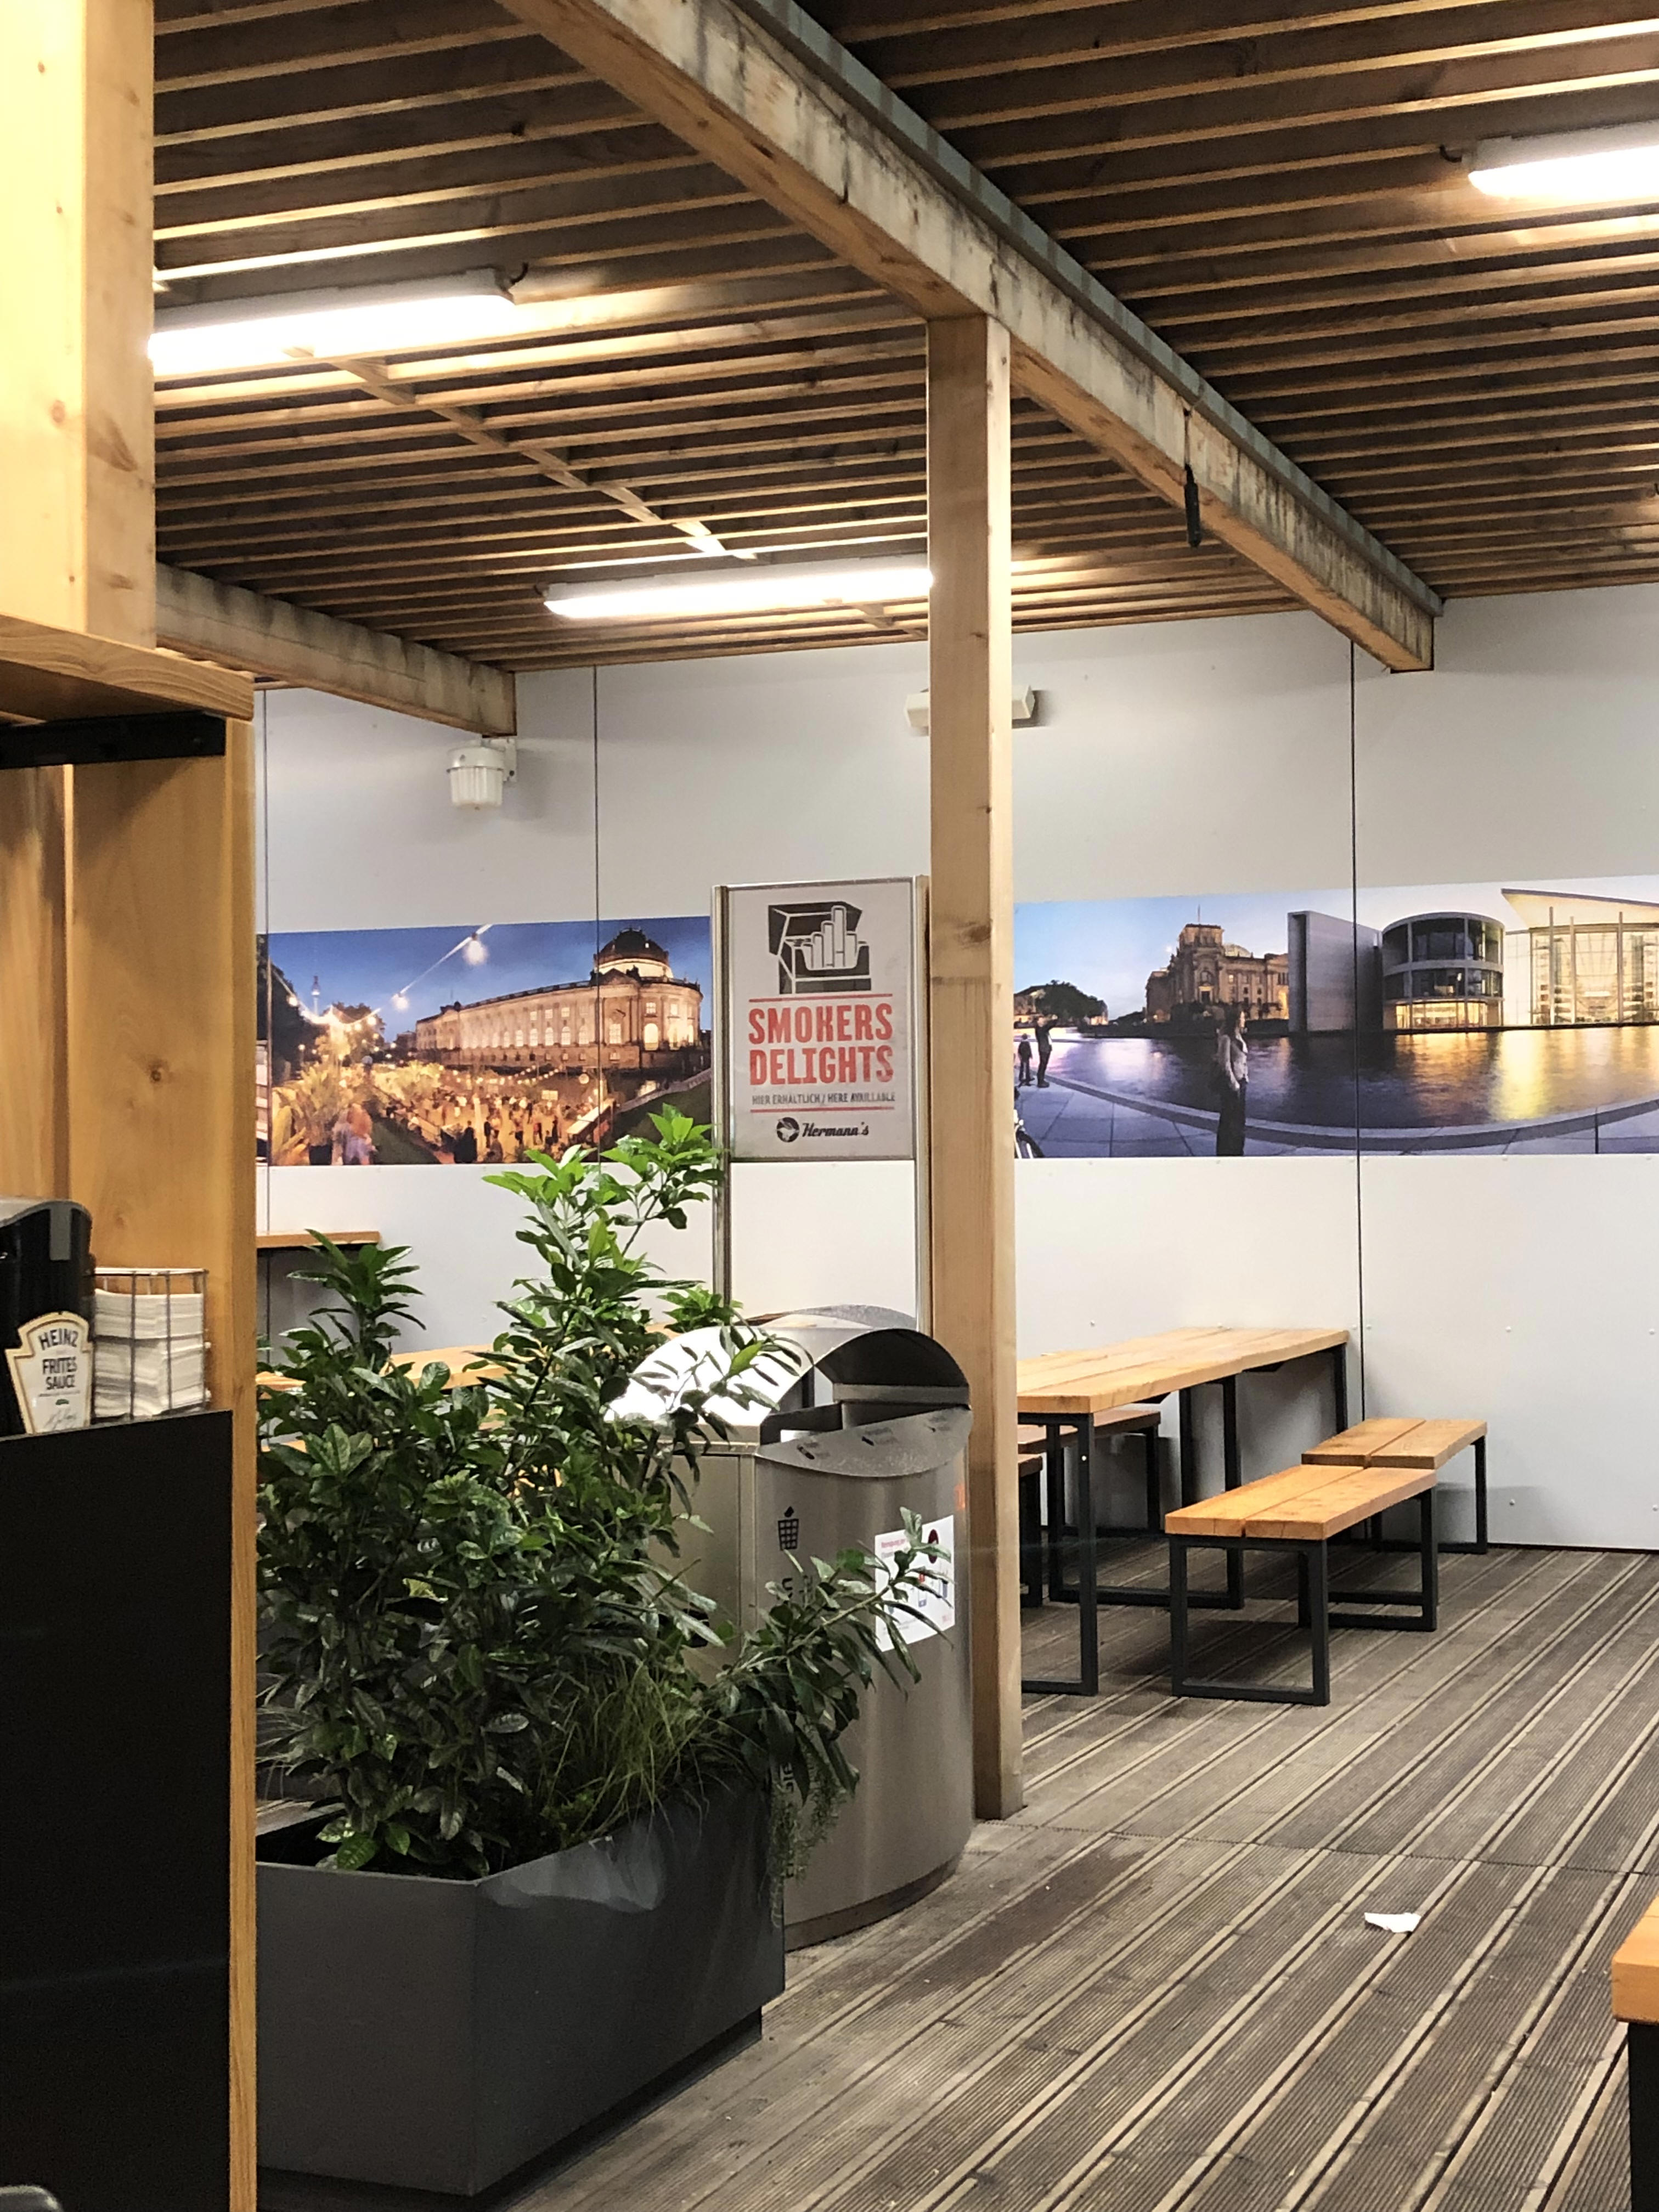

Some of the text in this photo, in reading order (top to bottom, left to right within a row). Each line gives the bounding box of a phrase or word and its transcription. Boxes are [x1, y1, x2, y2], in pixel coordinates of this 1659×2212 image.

[749, 1003, 893, 1044] SMOKERS
[750, 1045, 894, 1085] DELIGHTS
[752, 1095, 770, 1105] HIER
[827, 1093, 848, 1103] HERE
[802, 1122, 869, 1137] Hermann's
[38, 1328, 78, 1351] HEINZ
[46, 1375, 75, 1390] SAUCE
